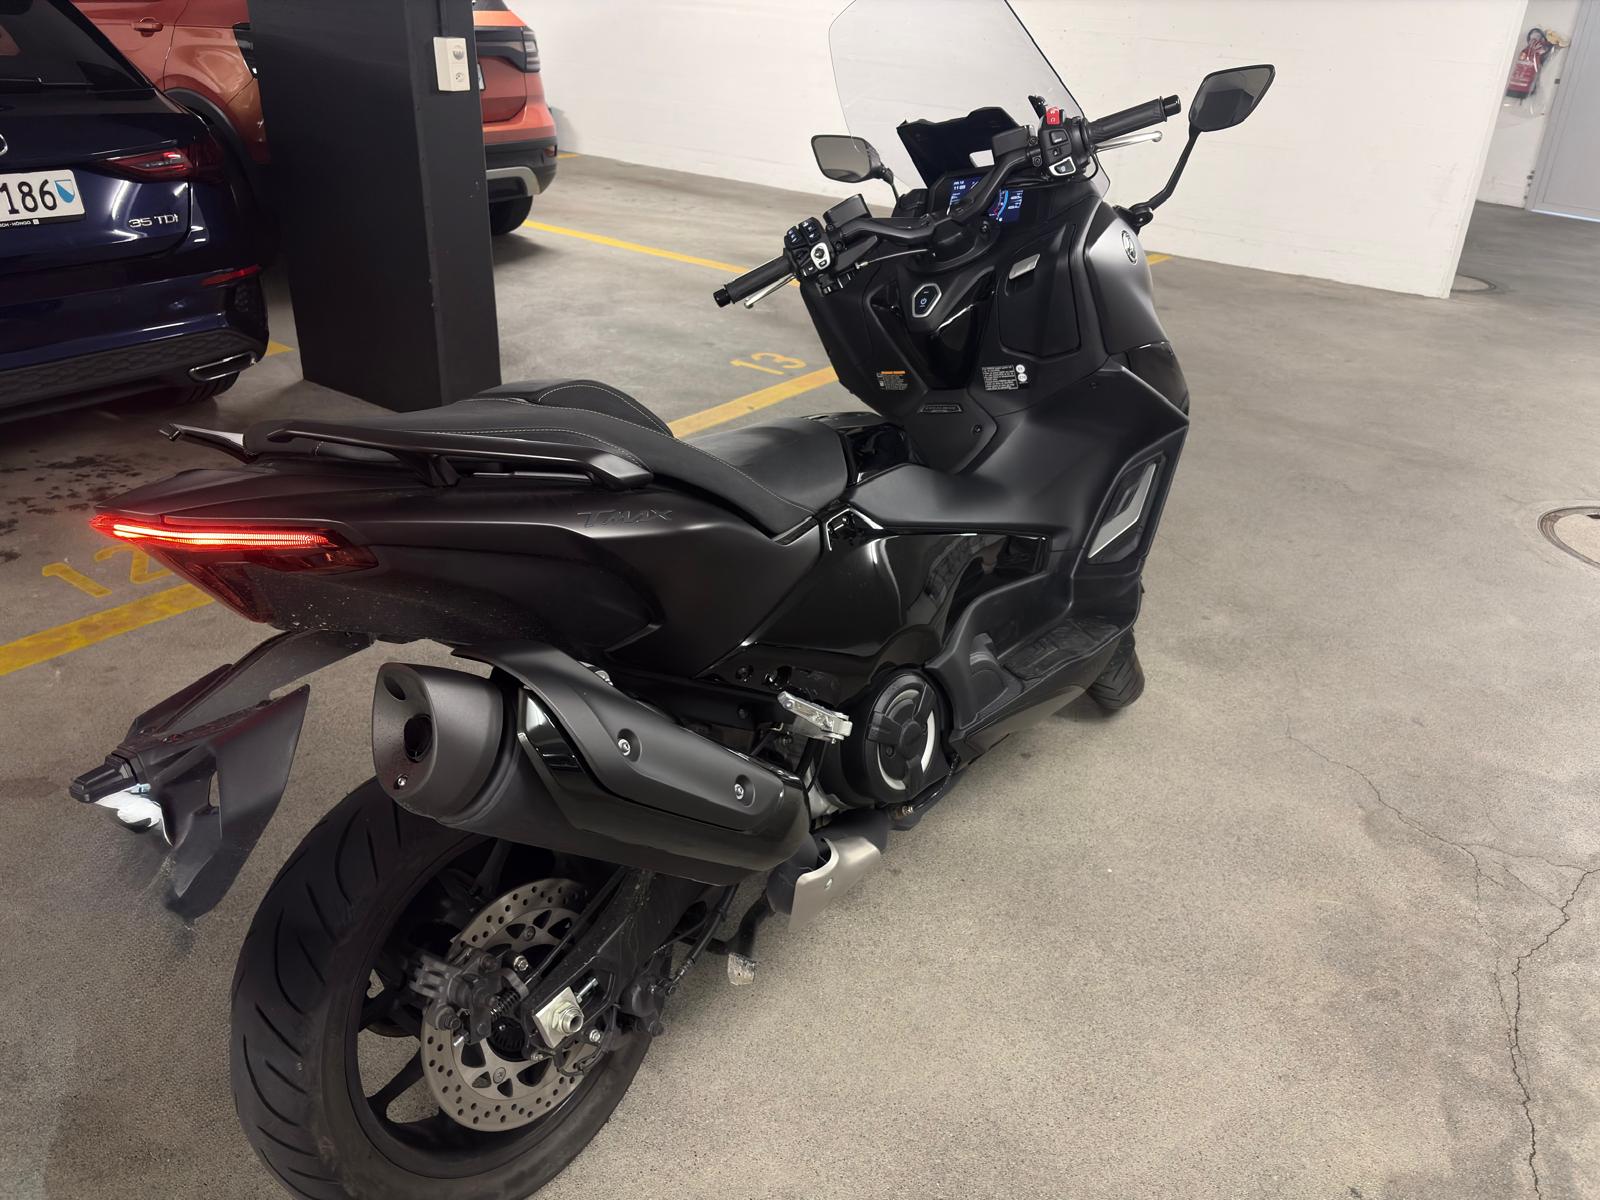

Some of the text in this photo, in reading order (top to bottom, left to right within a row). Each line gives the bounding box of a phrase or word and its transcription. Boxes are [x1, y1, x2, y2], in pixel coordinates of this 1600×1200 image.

[0, 179, 57, 215] 186
[128, 213, 179, 228] 35 TDI
[729, 352, 807, 375] 13
[42, 543, 173, 598] 12
